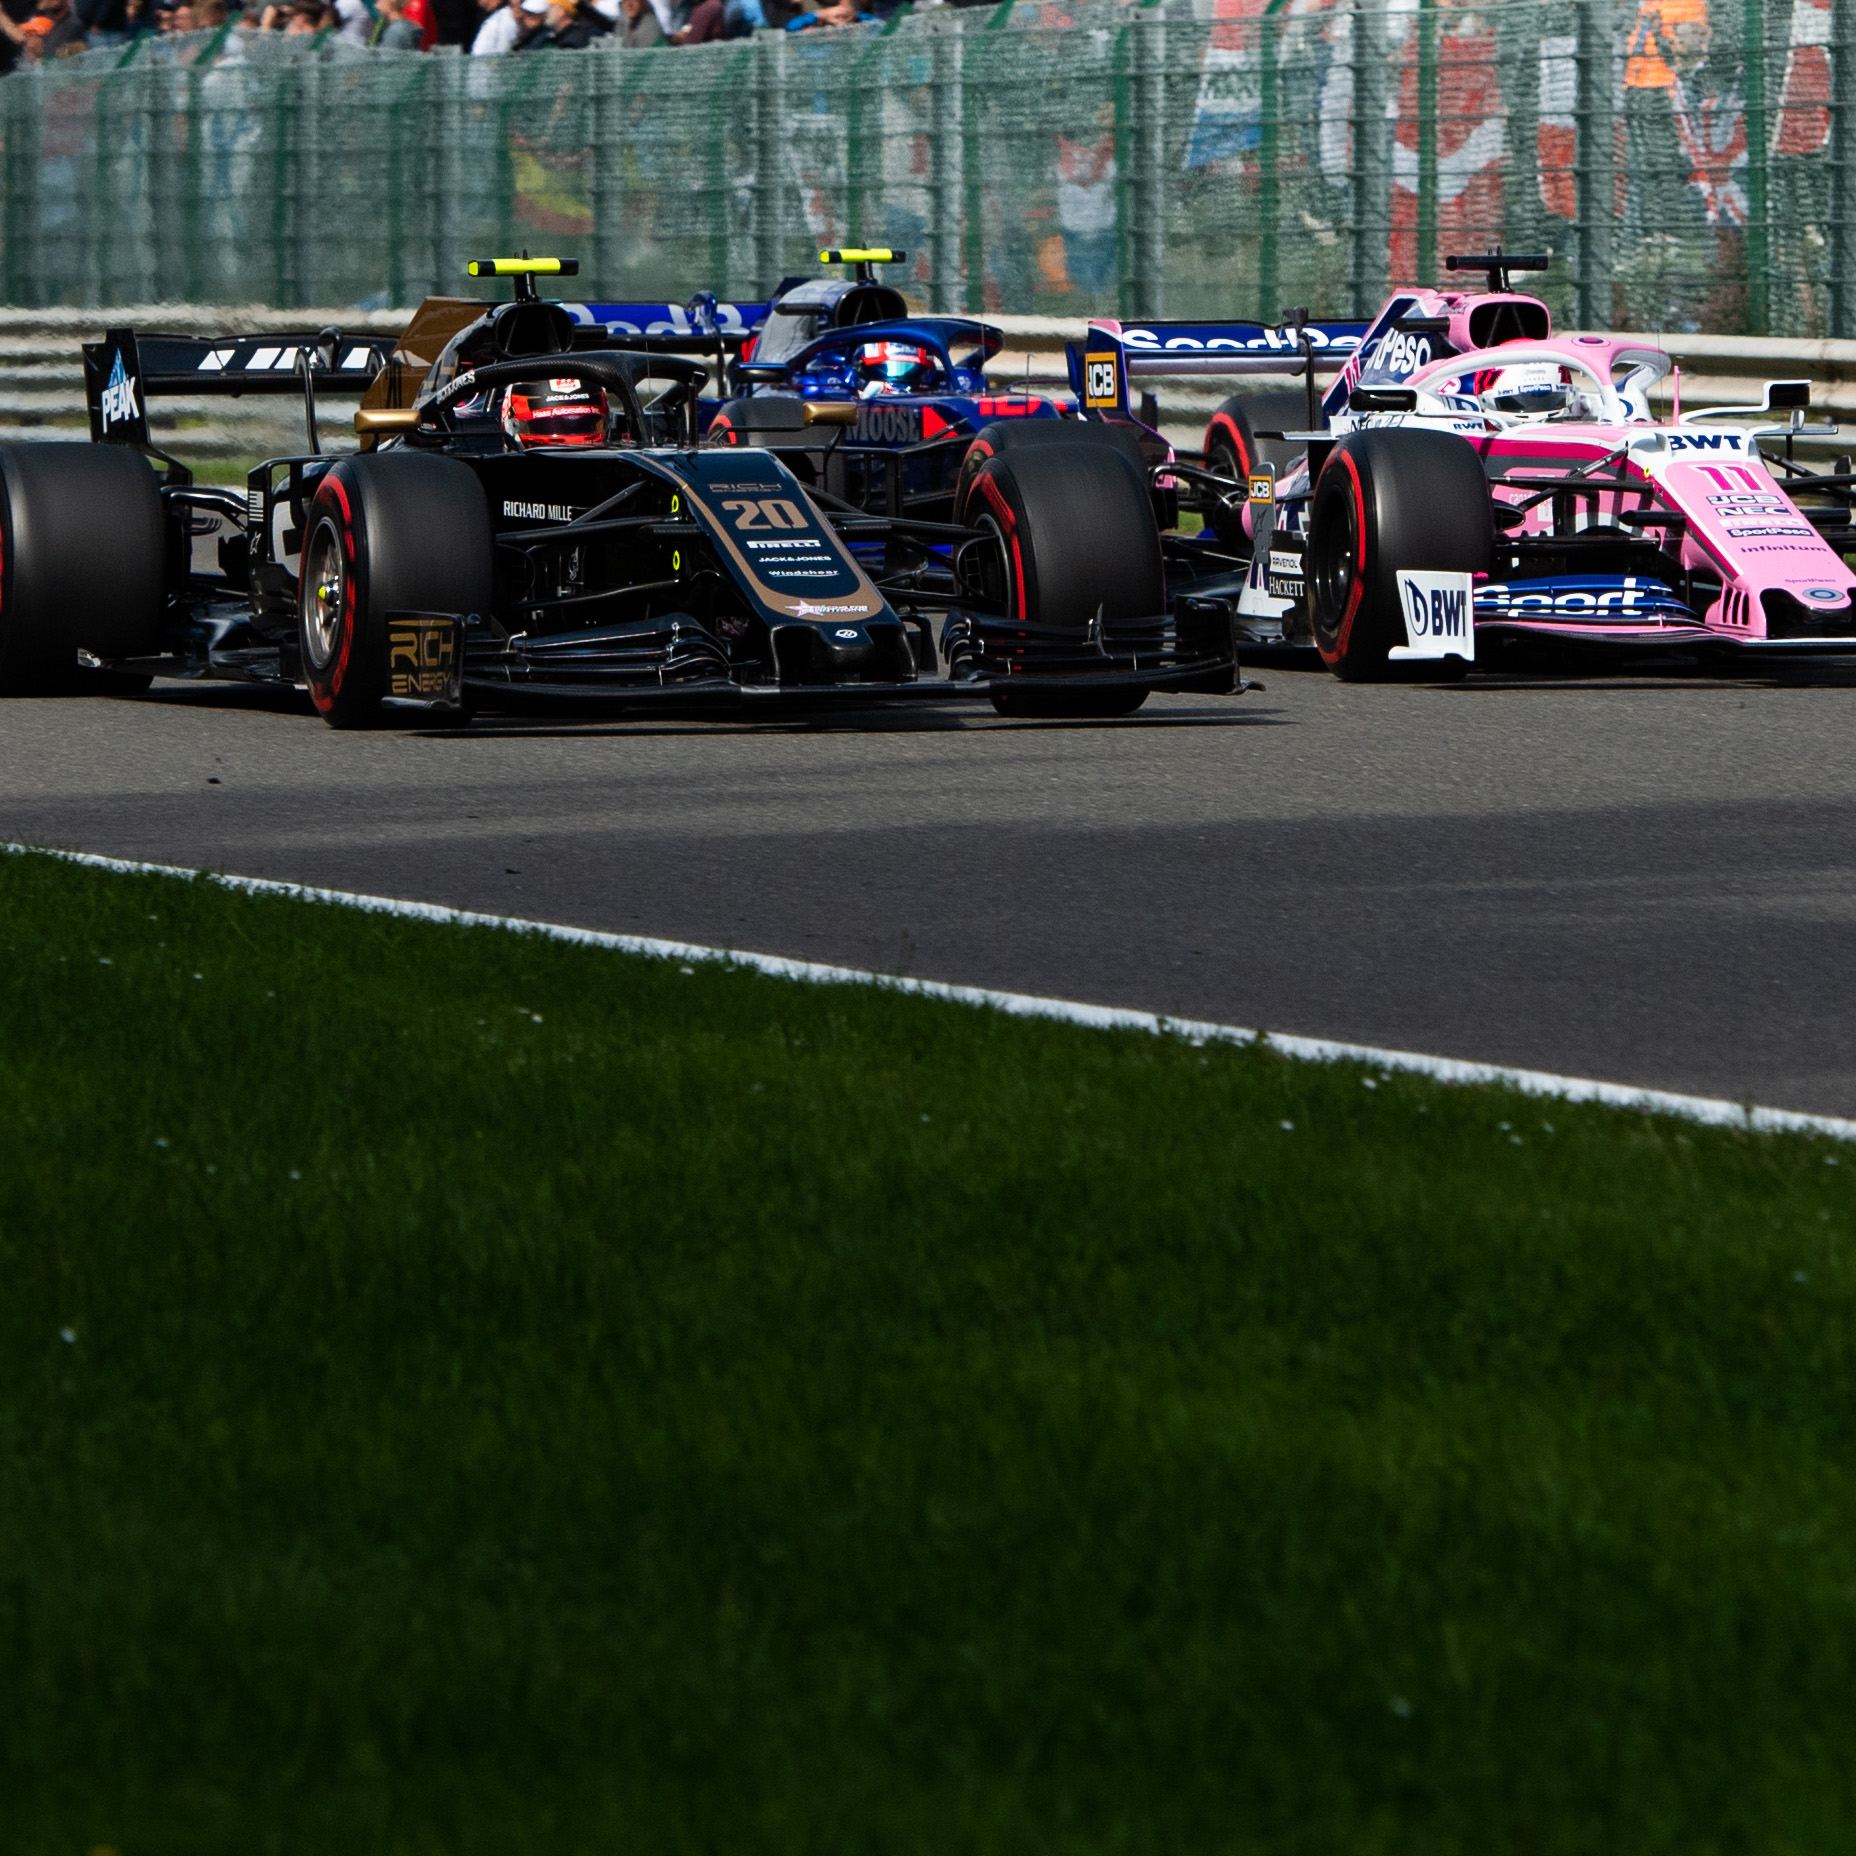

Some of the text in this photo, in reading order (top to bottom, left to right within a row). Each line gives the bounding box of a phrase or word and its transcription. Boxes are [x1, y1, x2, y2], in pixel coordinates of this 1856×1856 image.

[101, 376, 140, 434] PEAK
[845, 407, 920, 443] MOOSE
[1667, 435, 1742, 451] BWT
[1250, 481, 1270, 498] JCB
[1688, 464, 1769, 494] 11
[1709, 495, 1782, 504] JCB
[503, 500, 573, 522] RICHARD MILLE
[721, 499, 809, 530] 20
[1718, 506, 1792, 515] NEC
[1731, 528, 1812, 538] SportPesa
[746, 539, 822, 549] PIRELLI
[1269, 576, 1305, 597] HACKETT
[389, 630, 455, 669] RICH
[390, 672, 452, 694] ENERGY
